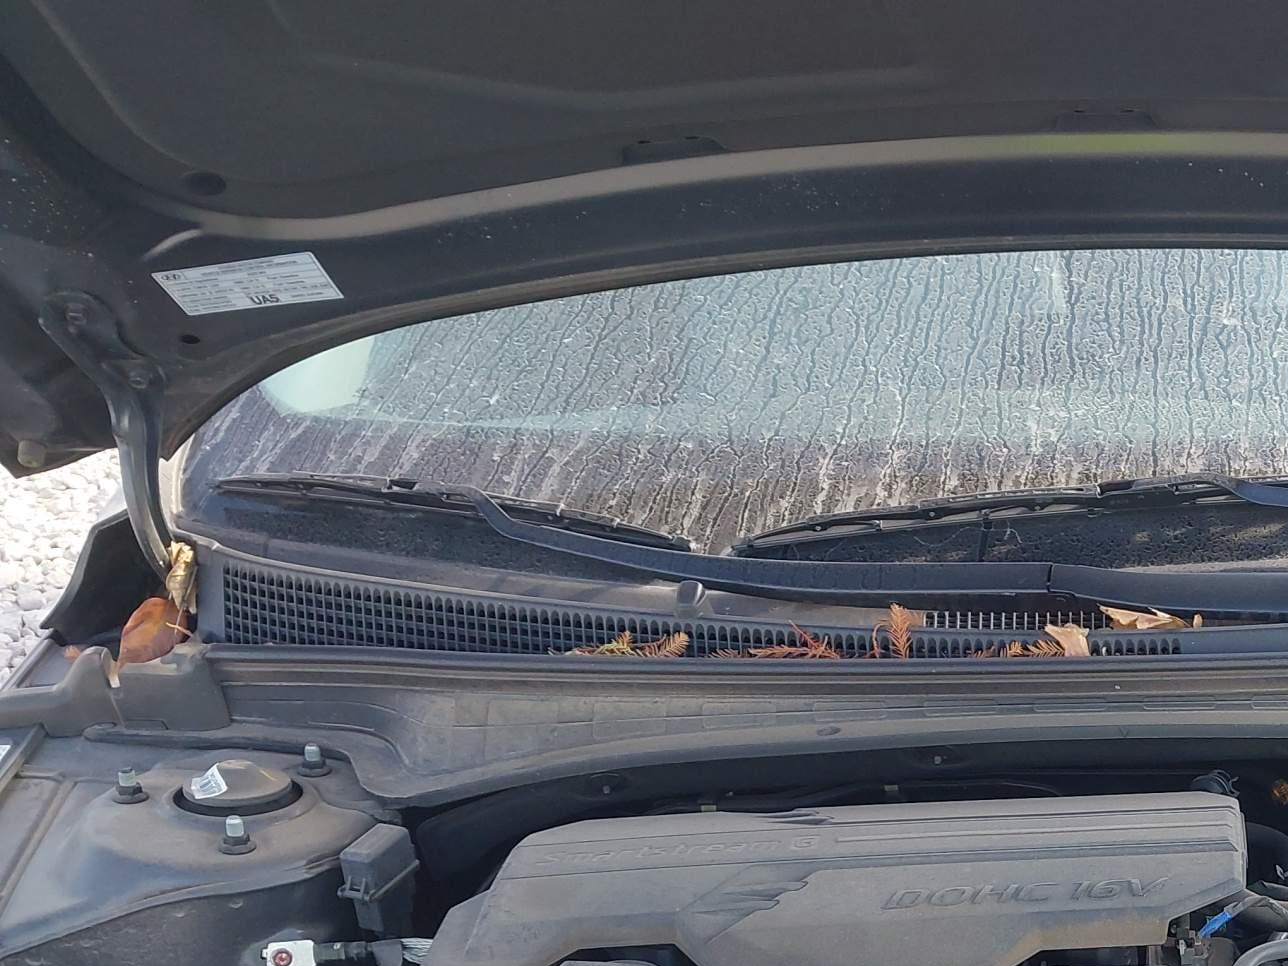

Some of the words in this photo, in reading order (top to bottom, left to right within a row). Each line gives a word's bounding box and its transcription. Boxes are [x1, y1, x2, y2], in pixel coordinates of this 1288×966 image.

[535, 840, 781, 864] Smartstream
[880, 882, 1057, 910] DOHC
[1070, 876, 1169, 901] 16V
